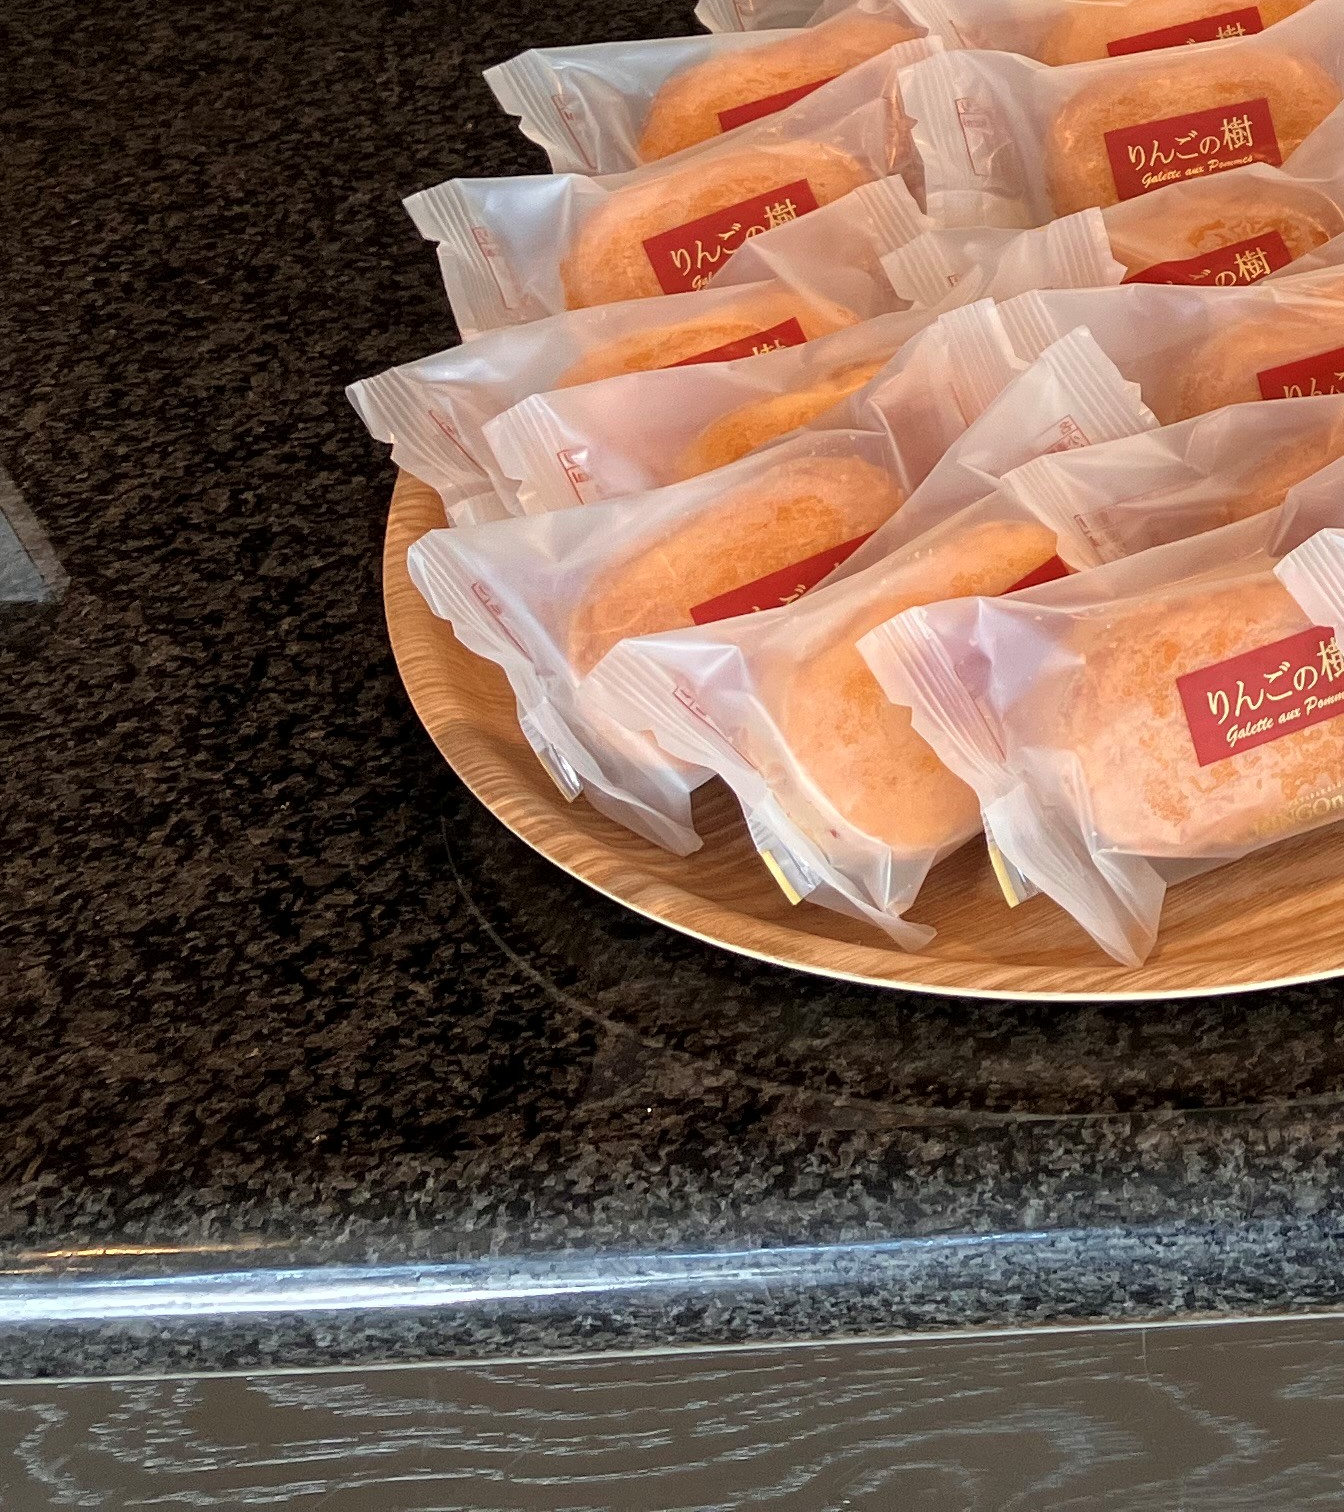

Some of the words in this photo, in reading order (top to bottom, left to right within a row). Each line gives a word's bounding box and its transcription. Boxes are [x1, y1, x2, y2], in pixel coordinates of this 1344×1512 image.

[1127, 114, 1254, 171] りんごの樹
[1141, 169, 1182, 189] Galette
[1185, 165, 1205, 176] aux
[1207, 153, 1254, 172] Pommes
[1226, 717, 1274, 748] Galette
[1278, 707, 1301, 724] aux
